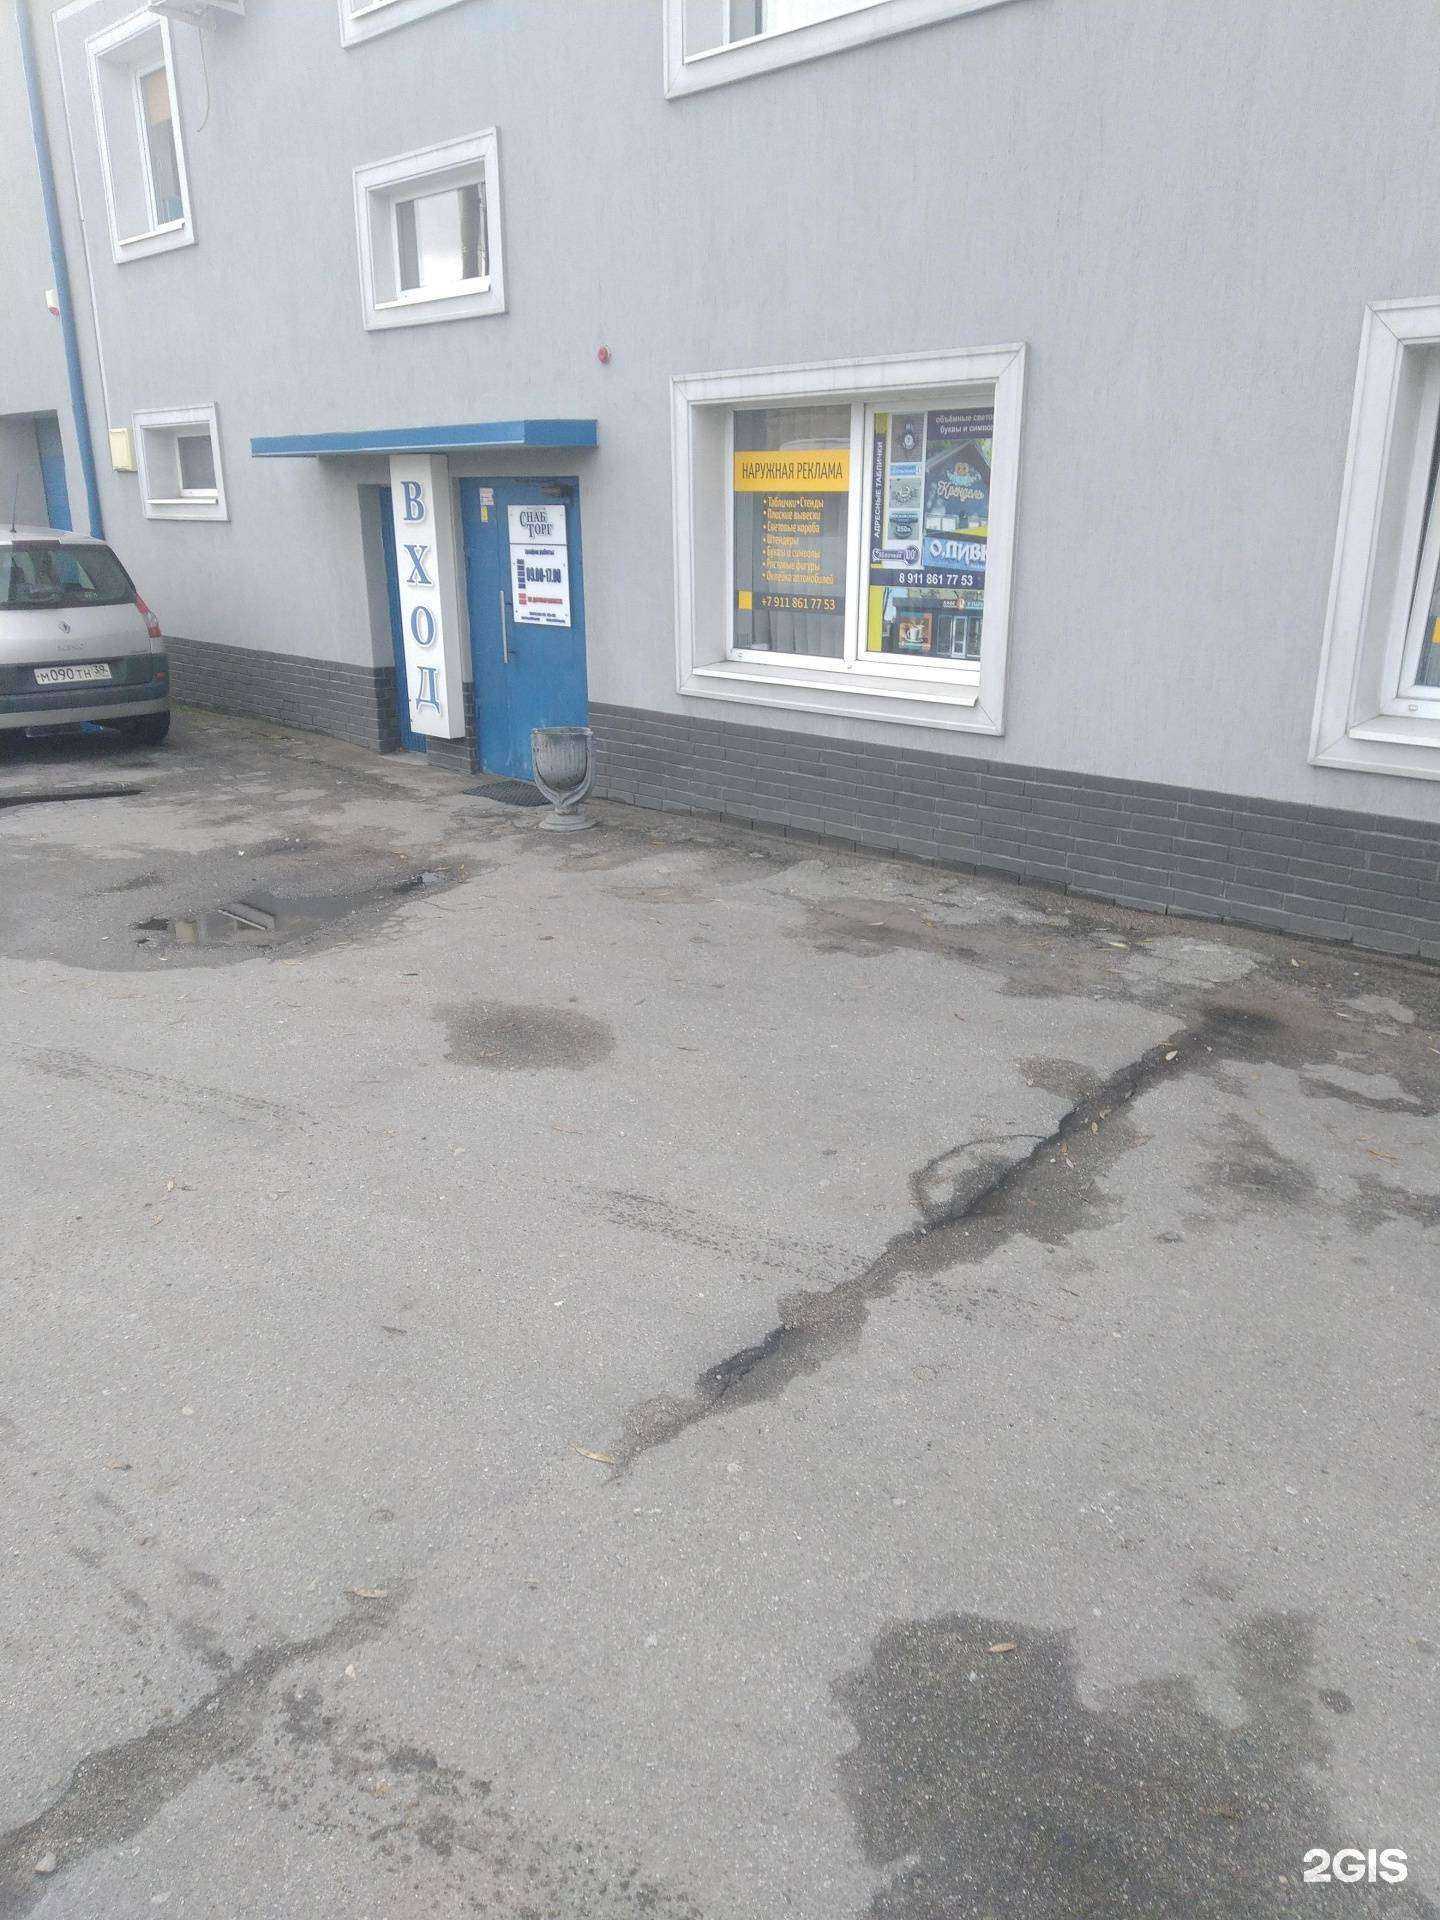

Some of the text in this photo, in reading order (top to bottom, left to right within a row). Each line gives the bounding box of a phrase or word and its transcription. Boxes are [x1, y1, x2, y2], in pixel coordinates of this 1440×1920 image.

[742, 462, 843, 480] НАРУЖНАЯ РЕКЛАМА
[874, 441, 883, 538] АДРЕСНЫЕ ТАБЛИЧКИ
[800, 496, 824, 508] Стенды
[899, 573, 974, 587] 8 911 861 77 53
[400, 480, 441, 715] ВХОД
[762, 596, 836, 610] +7 911 861 77 53
